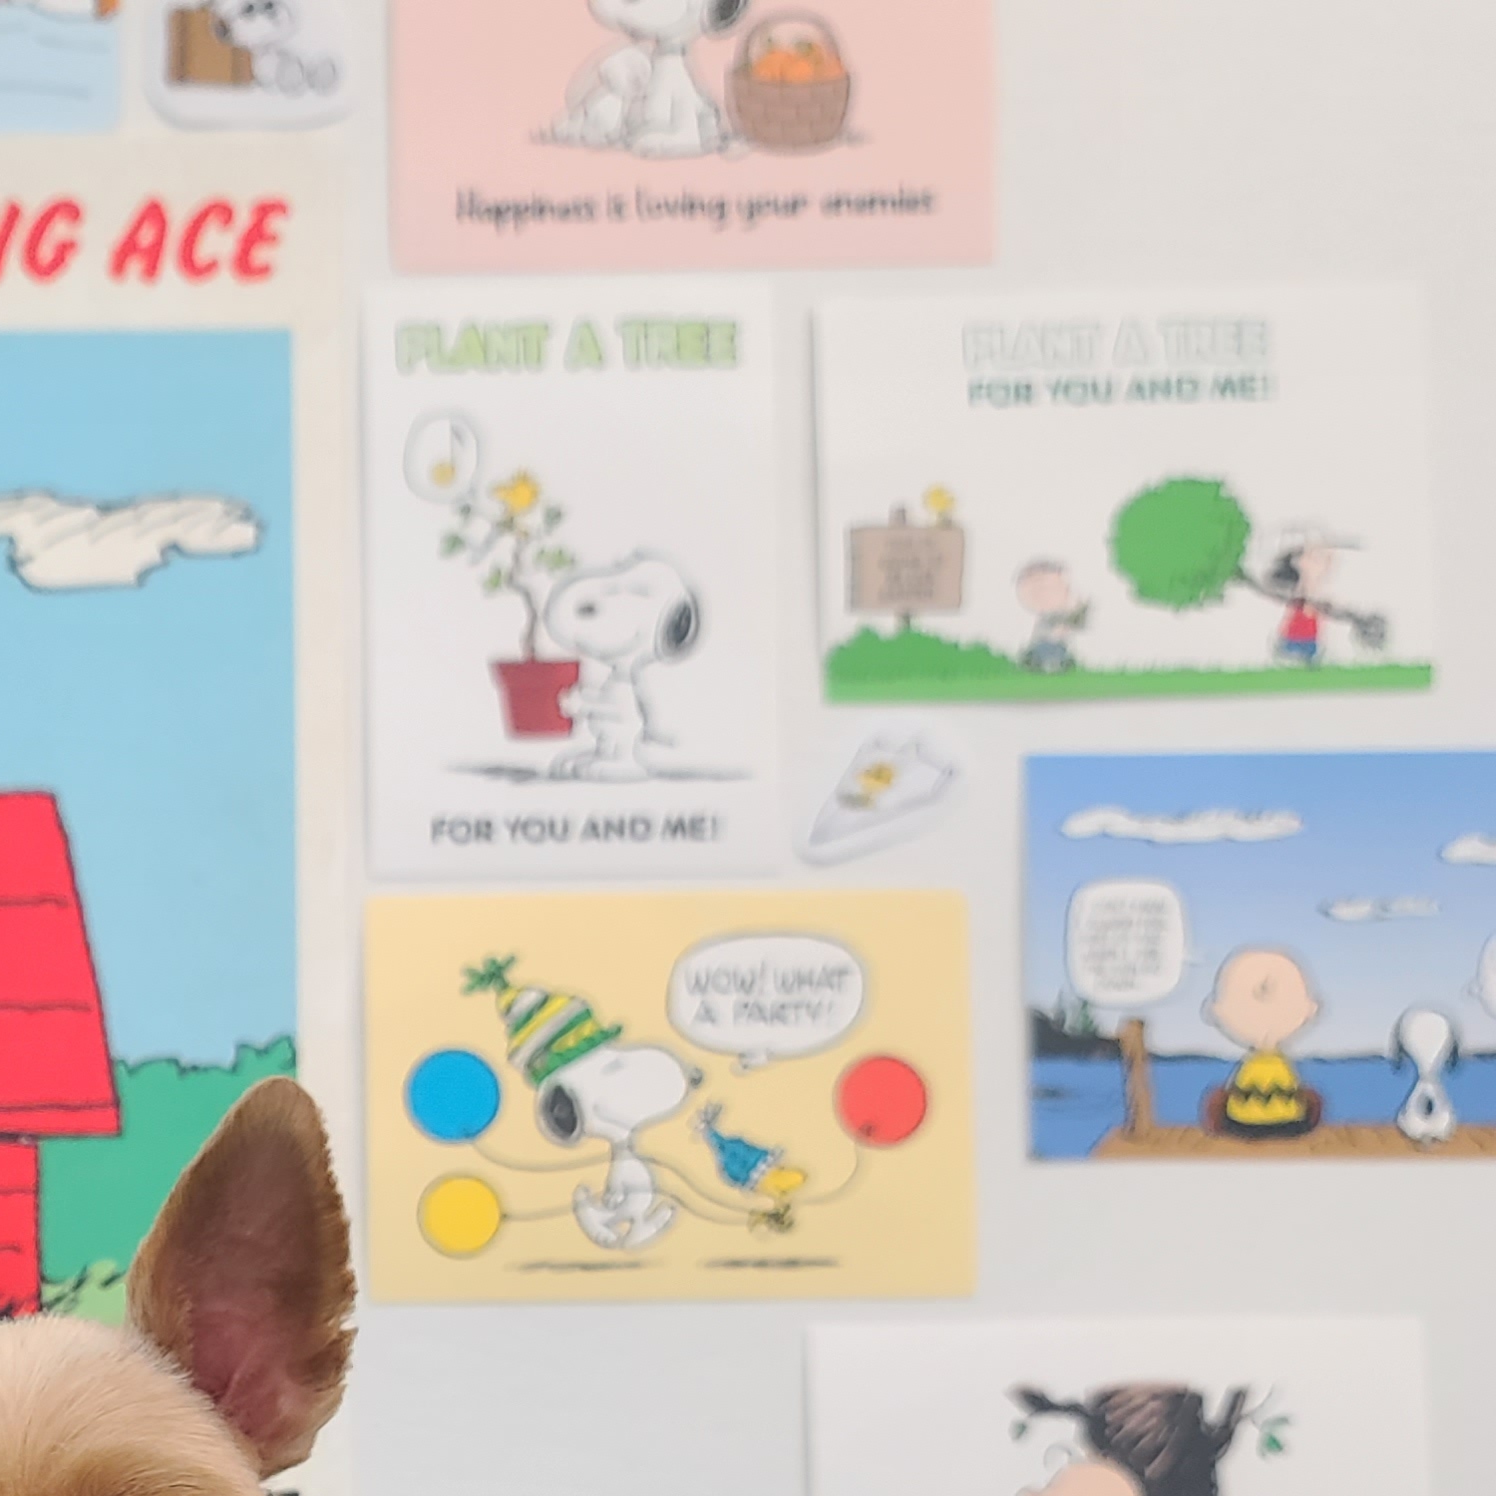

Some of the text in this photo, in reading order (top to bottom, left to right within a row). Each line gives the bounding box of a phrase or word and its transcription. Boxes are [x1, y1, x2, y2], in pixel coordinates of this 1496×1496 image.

[108, 196, 289, 283] ACE
[395, 315, 738, 375] PLANT A TREE
[960, 319, 1102, 371] PLANT
[1155, 314, 1271, 367] TREE
[967, 376, 1034, 408] FOR
[1046, 374, 1114, 407] YOU
[1124, 372, 1201, 404] AND
[430, 810, 720, 846] FOR YOU AND ME!
[684, 961, 850, 996] WOW! WHAT
[692, 999, 718, 1025] A
